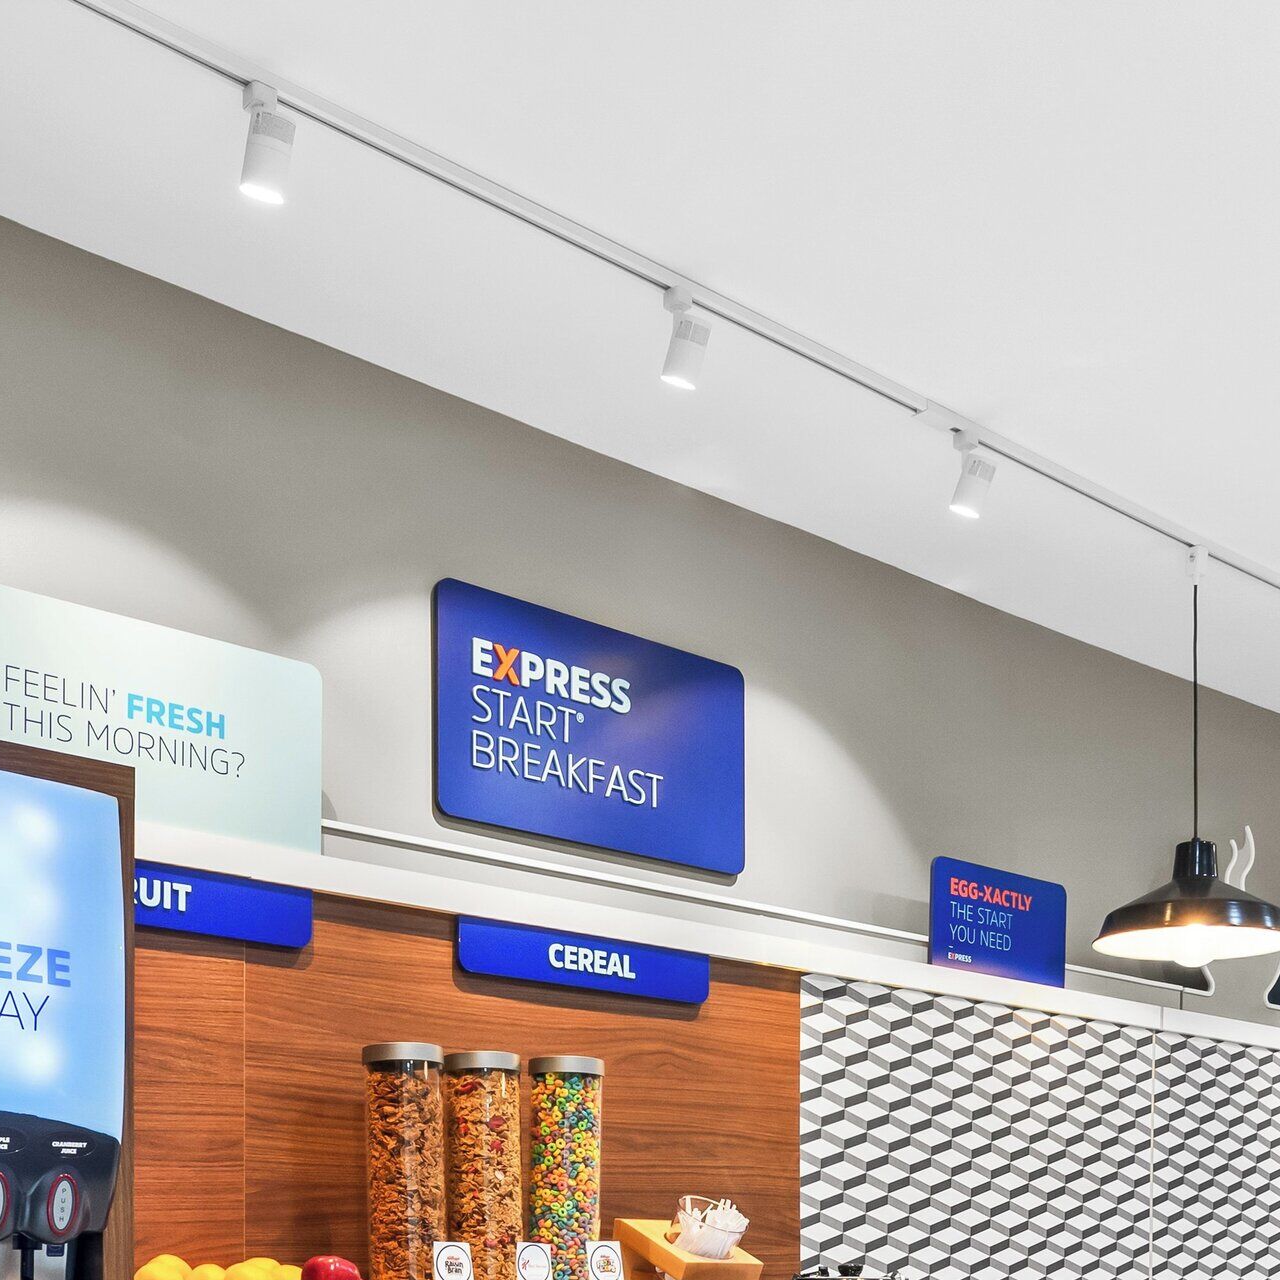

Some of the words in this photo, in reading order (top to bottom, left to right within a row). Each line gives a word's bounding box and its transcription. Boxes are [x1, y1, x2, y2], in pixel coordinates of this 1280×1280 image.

[472, 637, 632, 714] EXPRESS
[127, 693, 225, 739] FRESH
[3, 702, 73, 742] THIS
[88, 721, 245, 778] MORNING?
[472, 730, 664, 808] BREAKFAST
[134, 877, 192, 911] UIT
[950, 877, 1032, 912] EGG-XACTLY
[950, 901, 973, 921] THE
[978, 908, 1013, 930] START
[949, 923, 976, 944] YOU
[980, 930, 1011, 951] NEED
[548, 943, 635, 979] CEREAL
[948, 952, 972, 963] EXPRESS
[59, 1188, 67, 1221] PUSH
